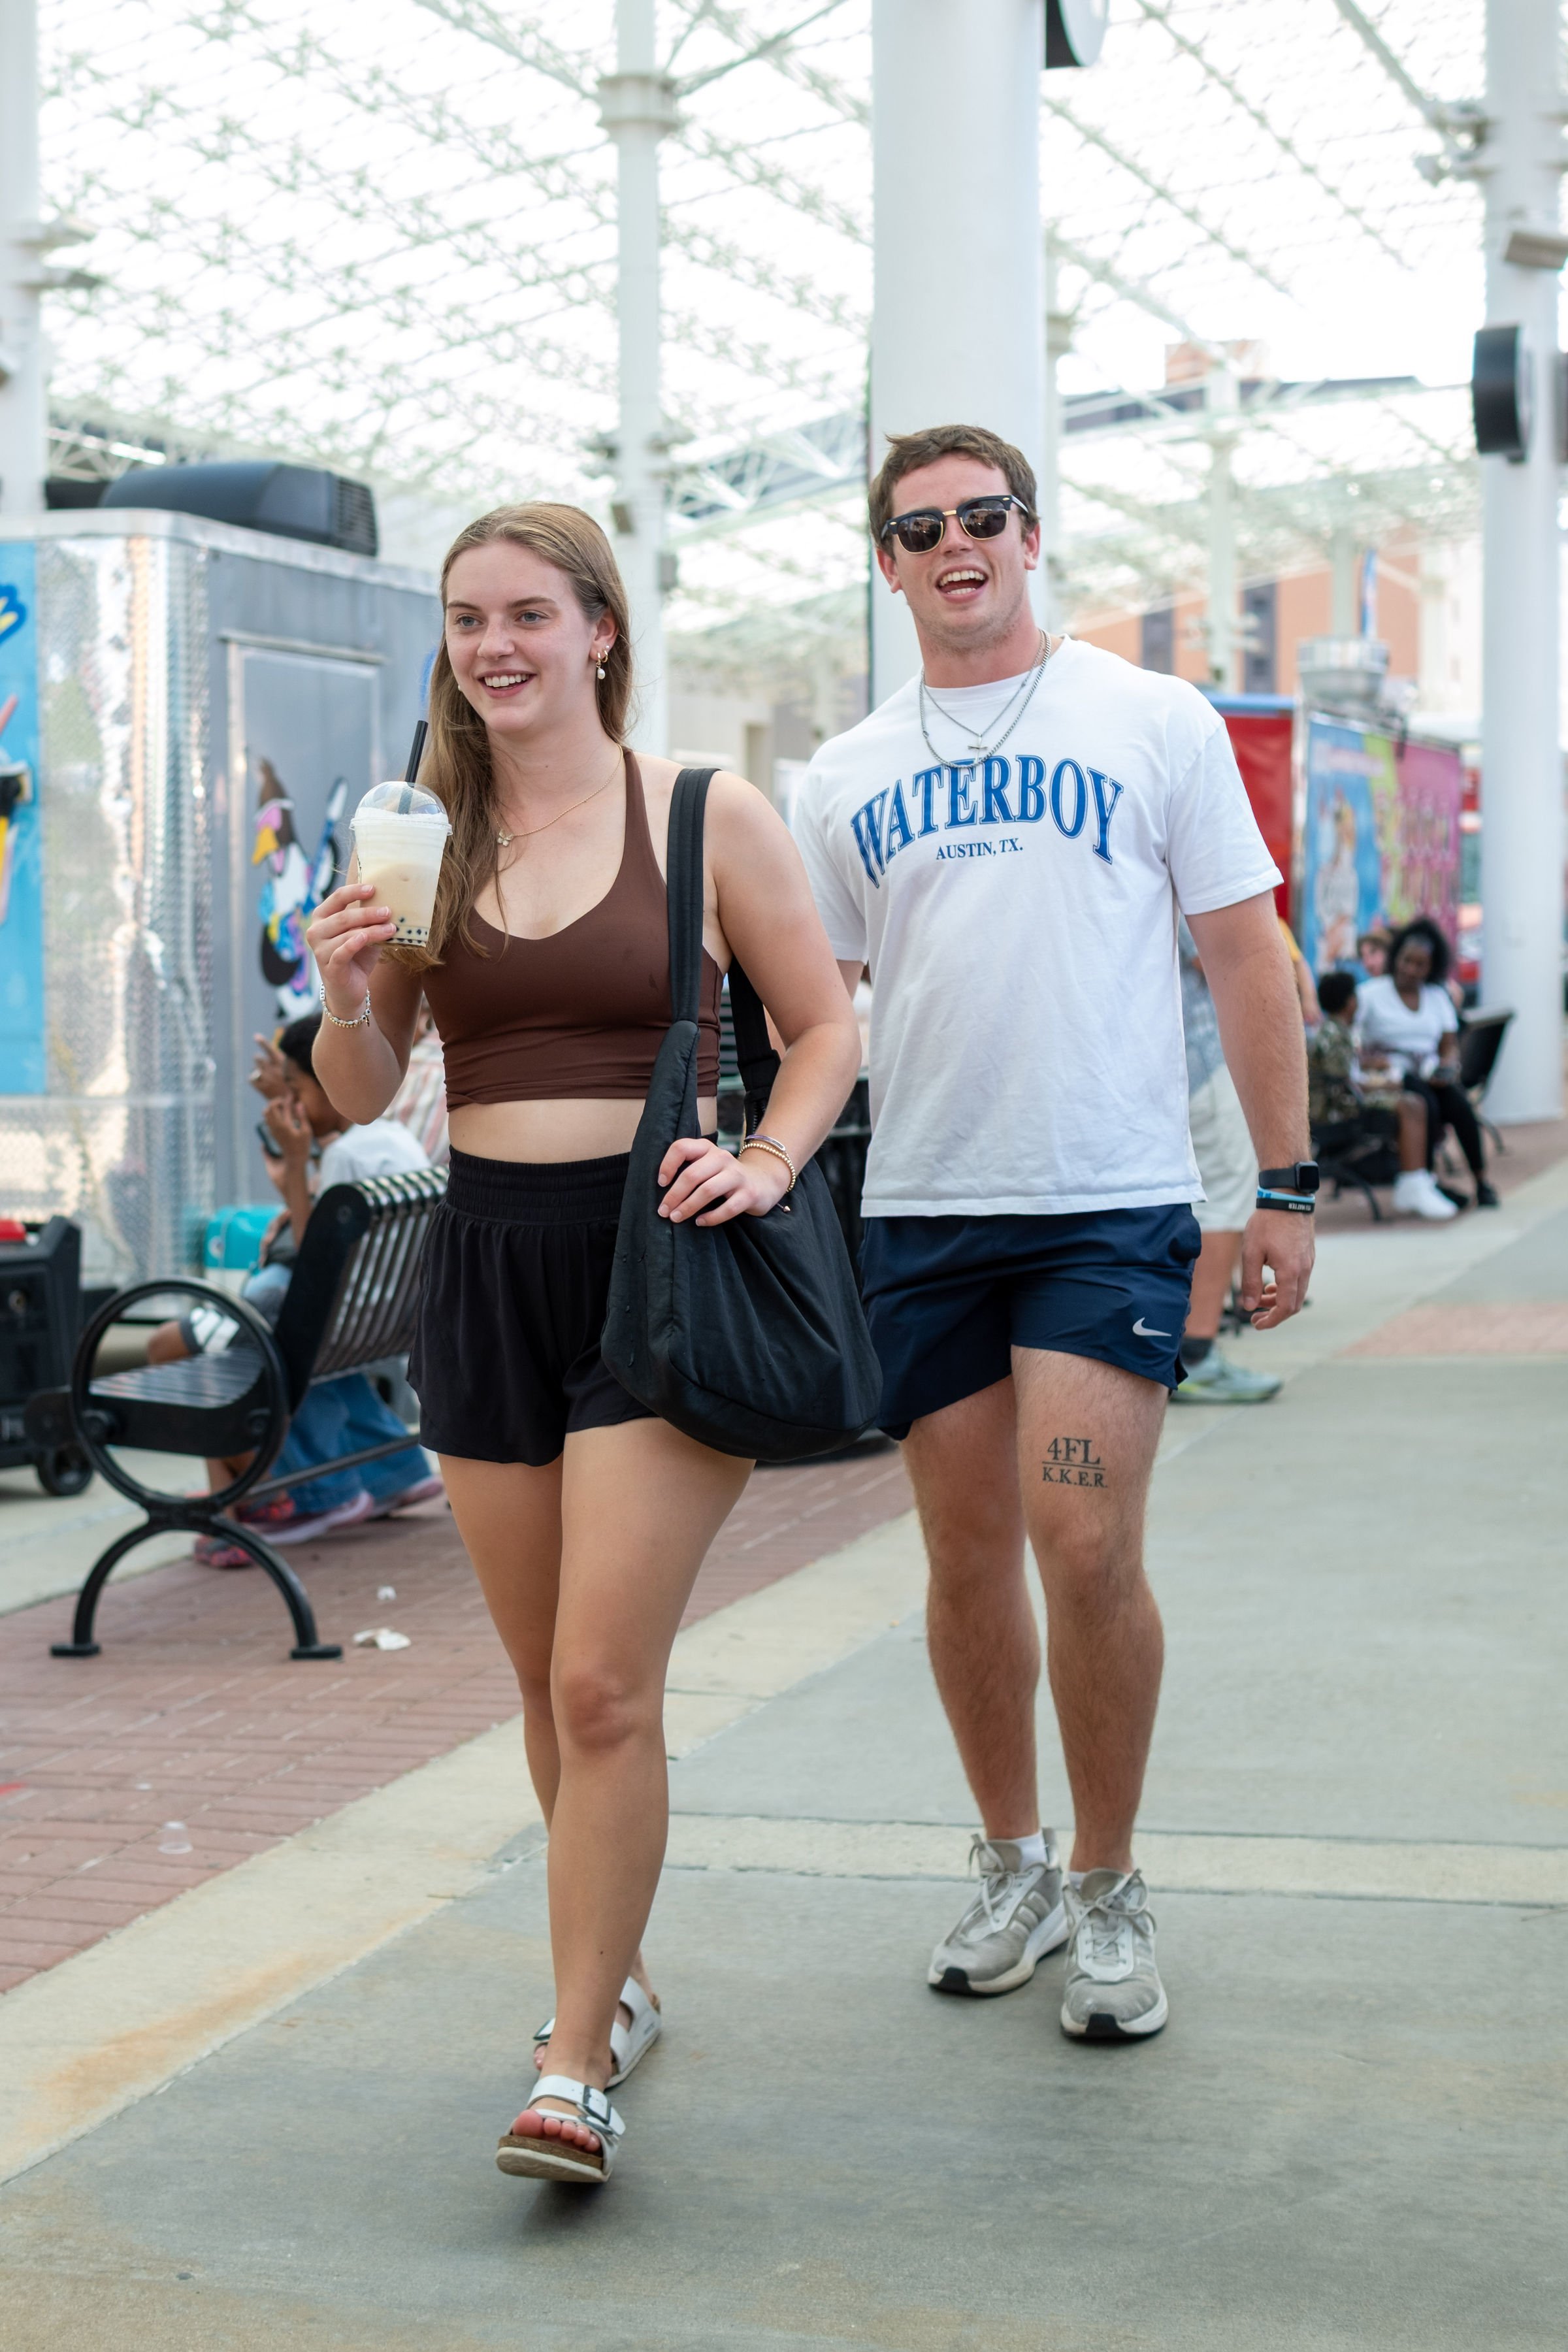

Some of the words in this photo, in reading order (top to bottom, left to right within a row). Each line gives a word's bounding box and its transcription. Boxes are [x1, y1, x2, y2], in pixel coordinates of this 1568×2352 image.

[850, 755, 1124, 889] WATERBOY
[936, 840, 996, 860] AUSTIN,
[999, 838, 1024, 853] TX.
[1047, 1437, 1101, 1465] 4FL
